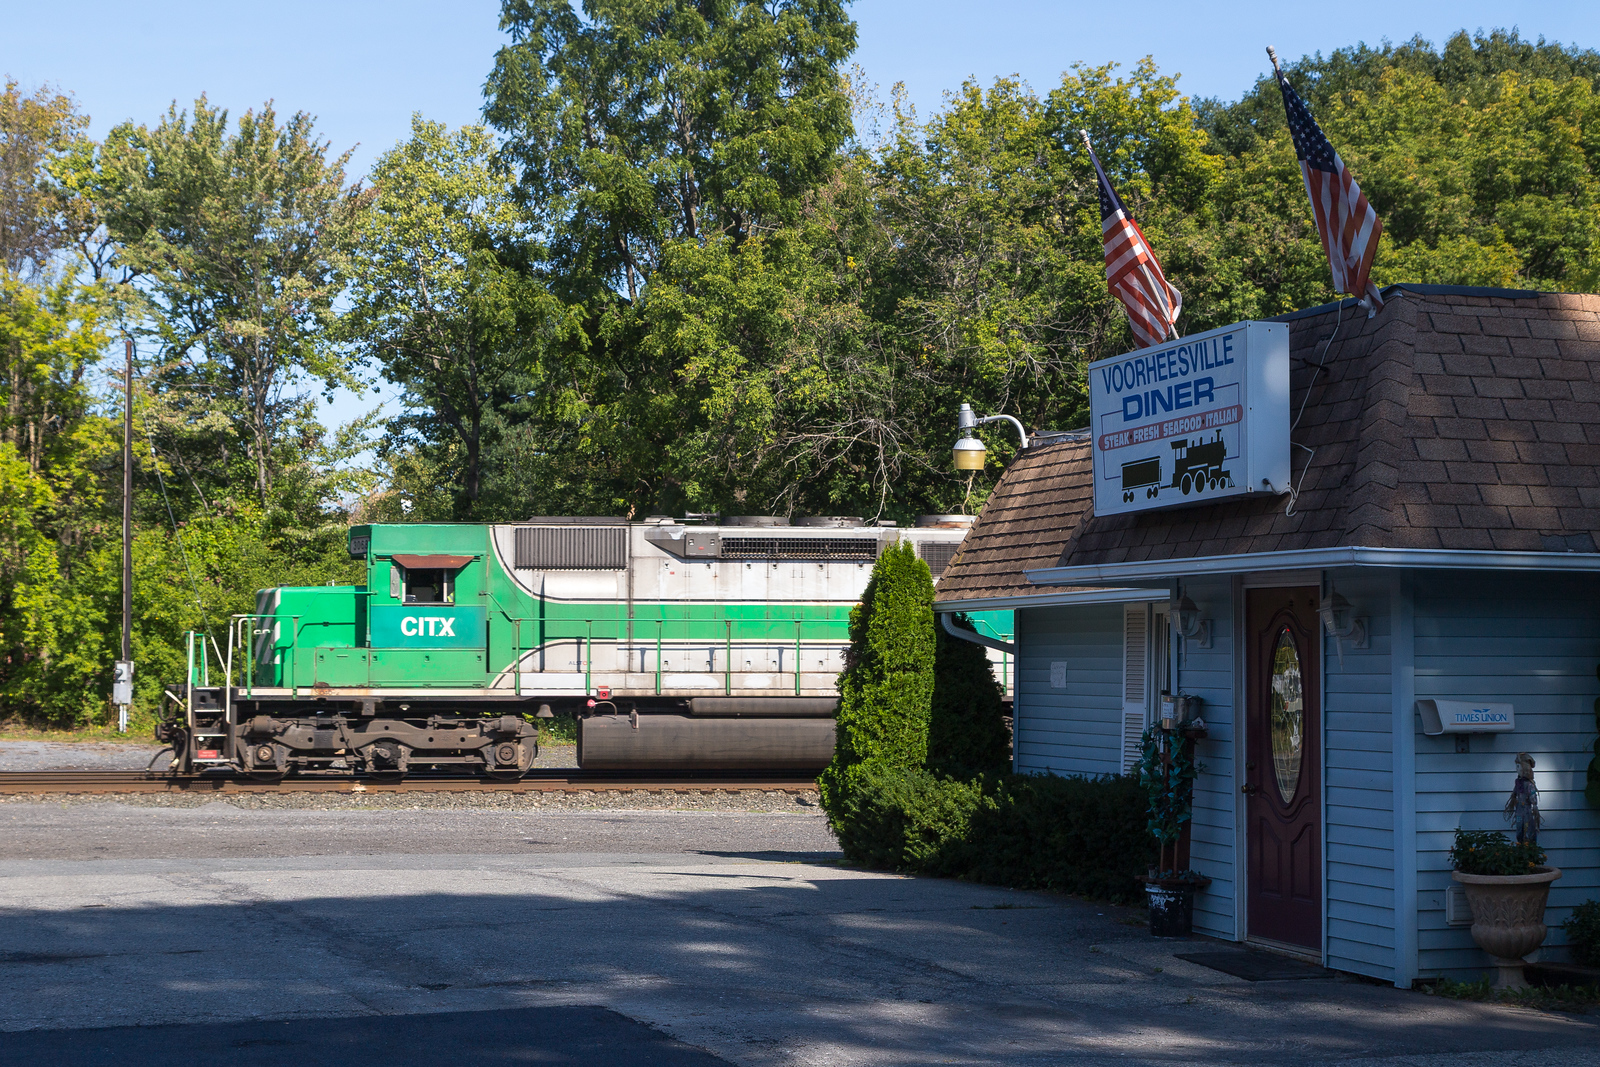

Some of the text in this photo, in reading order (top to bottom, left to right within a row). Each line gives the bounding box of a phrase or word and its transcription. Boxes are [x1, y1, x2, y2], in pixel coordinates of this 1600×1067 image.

[1102, 335, 1234, 394] VOORHEESVILLE
[1122, 376, 1214, 422] DINER
[1104, 407, 1238, 449] STEAK FRESH SEAFOOD ITALIAN
[401, 616, 456, 637] CITX
[1455, 713, 1507, 722] TIMES UNION
